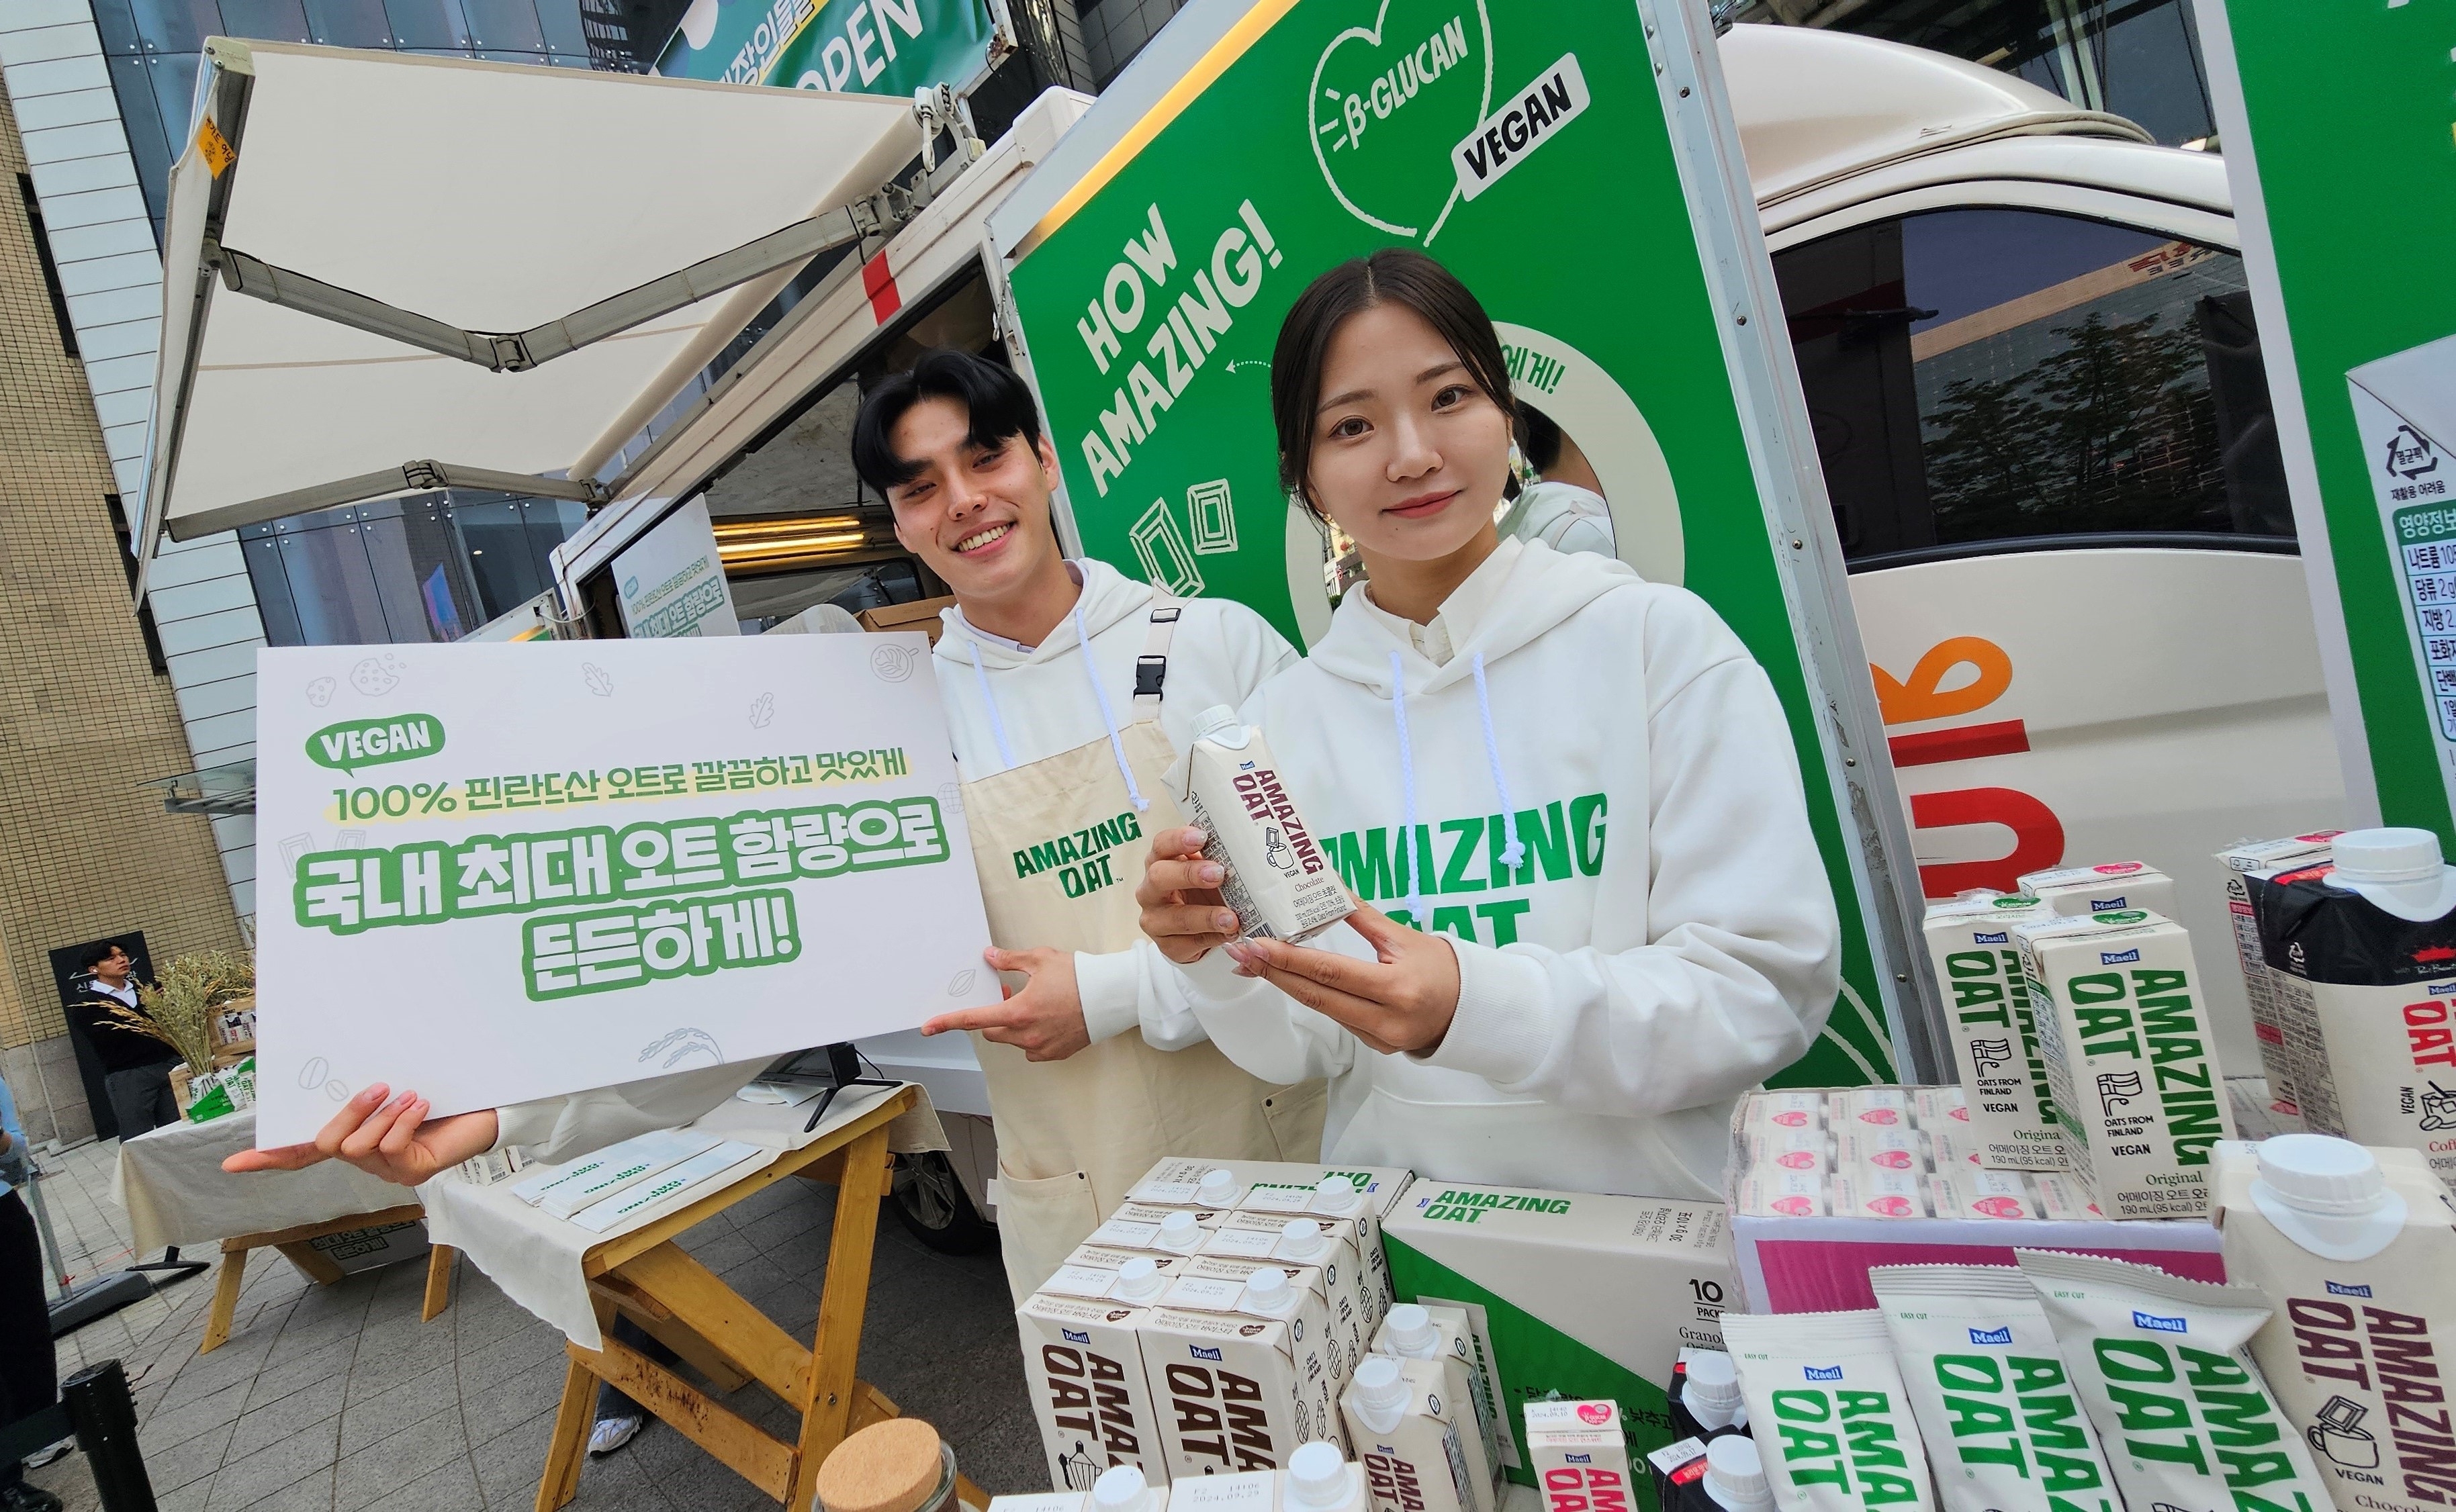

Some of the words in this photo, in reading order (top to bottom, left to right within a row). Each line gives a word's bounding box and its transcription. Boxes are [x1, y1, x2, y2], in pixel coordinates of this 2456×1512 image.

[796, 0, 923, 92] OPEN
[1463, 73, 1574, 181] VEGAN
[1077, 202, 1178, 376] HOW
[1080, 198, 1283, 498] AMAZING!
[2391, 485, 2416, 501] 재활용
[2418, 480, 2445, 497] 어려움
[2408, 546, 2440, 570] 나트륨
[2415, 578, 2437, 602] 당류
[668, 601, 688, 630] 오트
[683, 578, 724, 621] 함량으로
[2421, 608, 2444, 631] 지방
[320, 720, 431, 763] VEGAN
[332, 782, 457, 820] 100%
[465, 769, 600, 811] 핀란드산
[607, 764, 688, 799] 오트로
[692, 755, 813, 792] 깔끔하고
[815, 747, 907, 782] 맛있게
[1232, 773, 1275, 821] OAT
[1254, 770, 1324, 875] AMAZING
[1013, 812, 1142, 879] AMAZING
[306, 850, 443, 926] 국내
[457, 833, 611, 909] 최대
[622, 824, 725, 892] 오트
[729, 804, 942, 879] 함량으로
[1058, 854, 1113, 898] OAT
[1284, 869, 1300, 878] VEGAN
[1295, 876, 1324, 892] Chocolate
[2094, 900, 2126, 909] Maeil
[533, 896, 793, 992] 든든하게!
[1976, 933, 2007, 943] Maeil
[2103, 951, 2138, 963] Maeil
[1946, 950, 2011, 1029] OAT
[2067, 972, 2142, 1059] OAT
[2402, 1000, 2456, 1068] OAT
[2130, 970, 2225, 1166] AMAZING
[1983, 1103, 2019, 1113] VEGAN
[2400, 1086, 2415, 1115] VEGAN
[2104, 1117, 2126, 1127] OATS
[2128, 1115, 2154, 1125] FROM
[2107, 1127, 2143, 1137] FINLAND
[2013, 1129, 2061, 1142] Origina
[1989, 1143, 2030, 1155] 어메이징
[2032, 1145, 2054, 1154] 오트
[2054, 1145, 2066, 1155] 오
[1991, 1155, 2006, 1164] 190
[2036, 1155, 2055, 1166] kcal)
[2111, 1144, 2151, 1156] VEGAN
[2146, 1171, 2203, 1187] Original
[1435, 1190, 1572, 1215] AMAZING
[2118, 1190, 2164, 1203] 어메이징
[2167, 1189, 2191, 1200] 오트
[1423, 1205, 1488, 1223] OAT
[2121, 1204, 2137, 1215] 190
[2171, 1202, 2192, 1212] kcal)
[1669, 1234, 1682, 1242] 30
[1676, 1211, 1692, 1225] 10포
[1689, 1278, 1723, 1303] 10
[2054, 1290, 2069, 1298] EASY
[2329, 1284, 2371, 1297] Maeil
[1697, 1307, 1725, 1319] PACK
[1901, 1312, 1915, 1320] EASY
[2136, 1315, 2185, 1332] Maeil
[1064, 1331, 1089, 1343] Maeil
[1201, 1325, 1233, 1335] 바리스타
[1972, 1329, 2009, 1343] Maeil
[1191, 1346, 1222, 1360] Maeil
[2287, 1298, 2371, 1391] OAT
[1306, 1351, 1316, 1365] OATS
[1308, 1358, 1318, 1374] FROM
[1308, 1364, 1322, 1384] FINLAND
[1807, 1368, 1841, 1380] Maeil
[1042, 1344, 1099, 1442] OAT
[1321, 1379, 1329, 1405] VEGAN
[1166, 1363, 1230, 1466] OAT
[1934, 1354, 2030, 1479] OAT
[2093, 1337, 2210, 1476] OAT
[2362, 1305, 2456, 1505] AMAZING
[1772, 1390, 1852, 1495] OAT
[1835, 1390, 1919, 1512] AMA
[1567, 1455, 1590, 1463] Maeil
[1364, 1454, 1399, 1504] OAT
[2334, 1468, 2384, 1486] VEGAN
